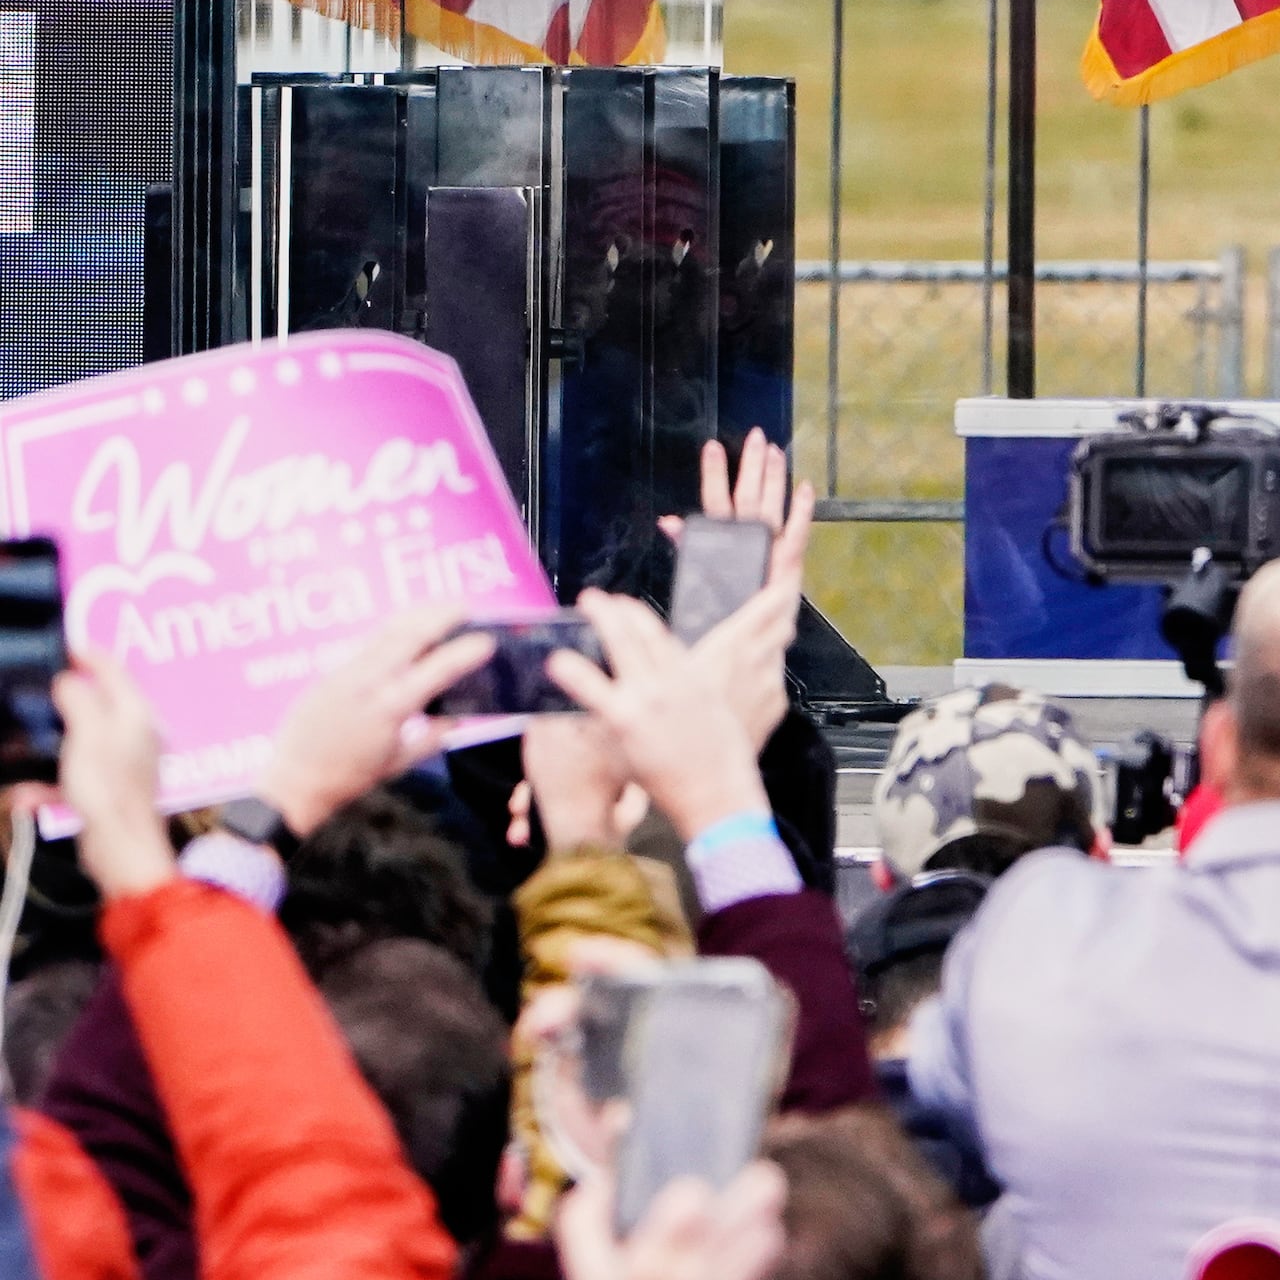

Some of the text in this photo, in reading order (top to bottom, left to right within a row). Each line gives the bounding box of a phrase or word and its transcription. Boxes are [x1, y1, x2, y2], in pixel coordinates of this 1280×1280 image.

[73, 416, 475, 564] Women
[114, 563, 374, 666] America
[381, 530, 519, 610] First
